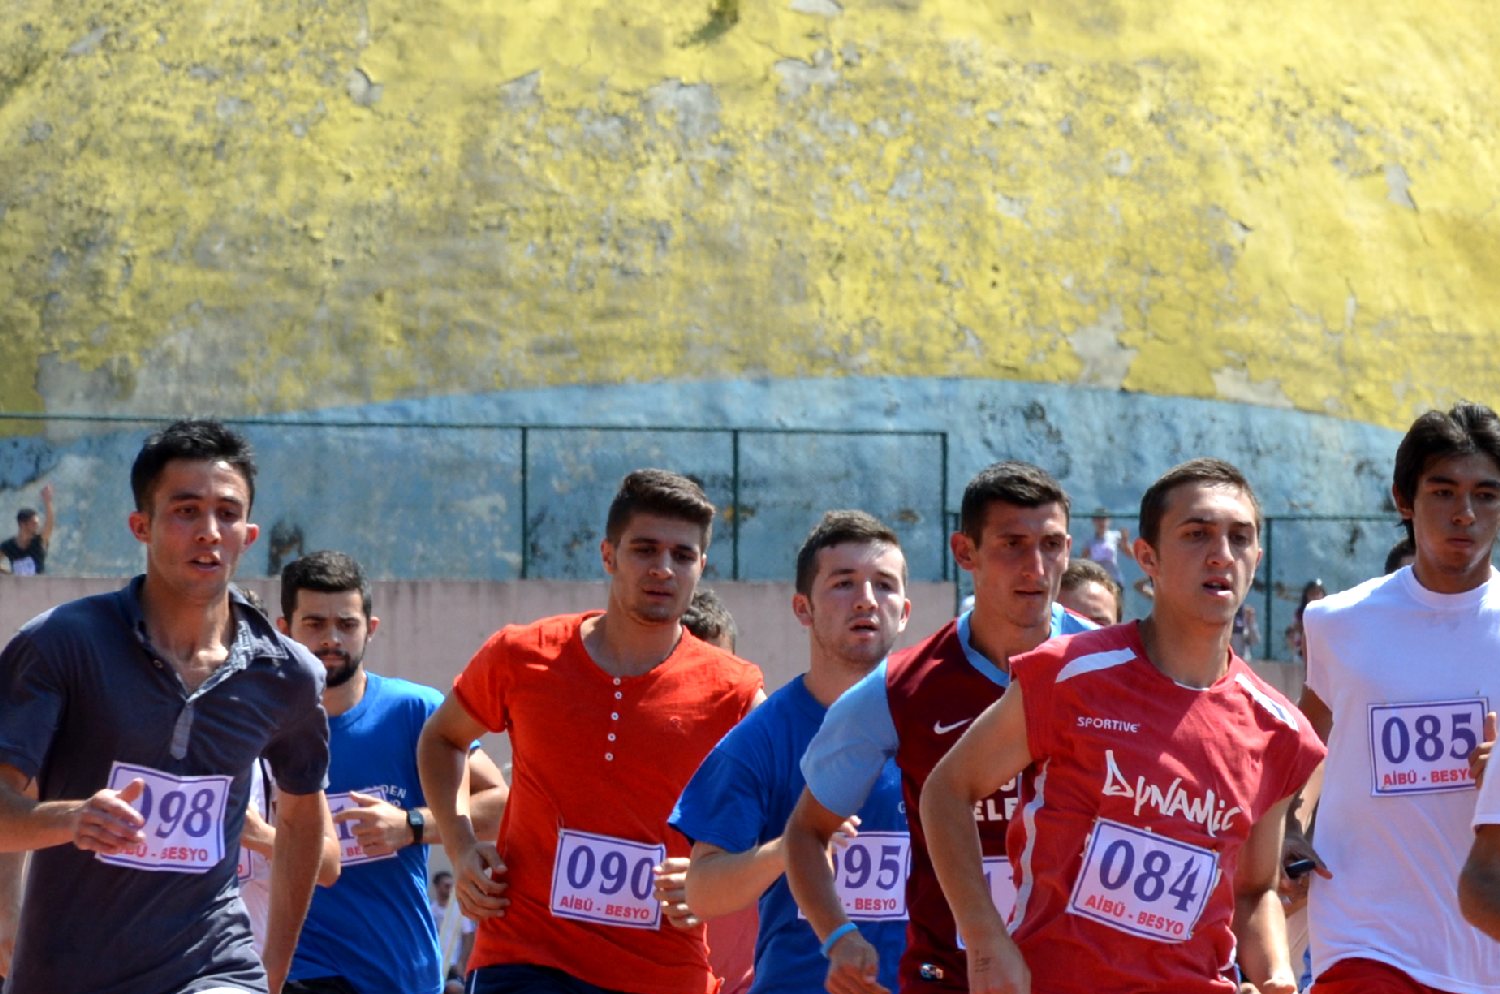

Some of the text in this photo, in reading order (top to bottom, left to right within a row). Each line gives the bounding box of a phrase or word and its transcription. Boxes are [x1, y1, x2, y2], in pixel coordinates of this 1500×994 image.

[1076, 716, 1138, 733] SPORTIVE
[1381, 711, 1477, 764] 085
[1383, 769, 1417, 786] AİBÜ
[567, 845, 655, 900] 090
[832, 844, 902, 890] 95
[1099, 839, 1201, 913] 084
[560, 894, 593, 911] AİBÜ
[605, 904, 650, 919] BESYO
[855, 897, 897, 911] BESYO
[1085, 893, 1126, 918] AİBÜ
[1137, 911, 1184, 935] BESYO
